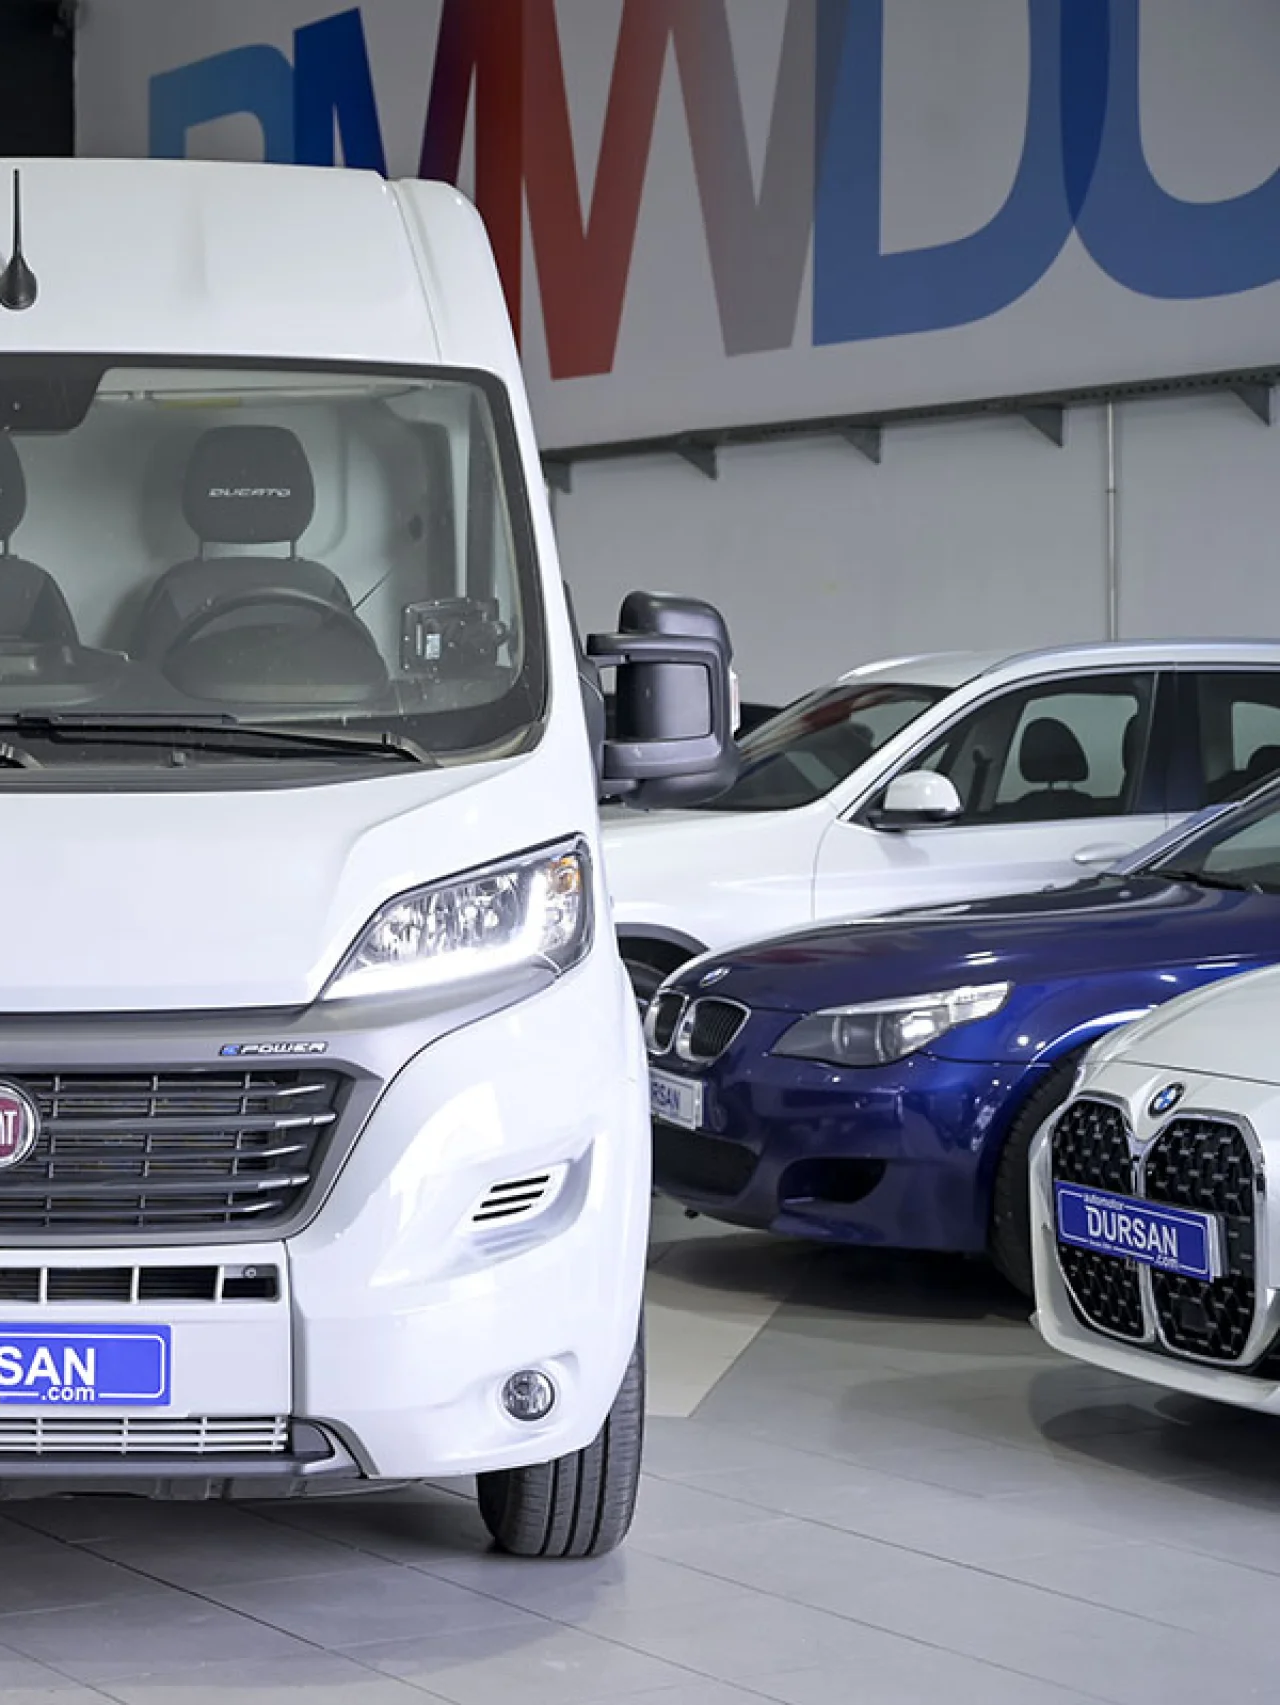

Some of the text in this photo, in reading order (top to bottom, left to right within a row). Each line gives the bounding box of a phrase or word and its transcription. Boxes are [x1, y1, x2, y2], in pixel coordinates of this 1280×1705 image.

[208, 487, 291, 498] DUCATO
[1084, 1205, 1179, 1258] DURSAN
[41, 1385, 95, 1402] .com
